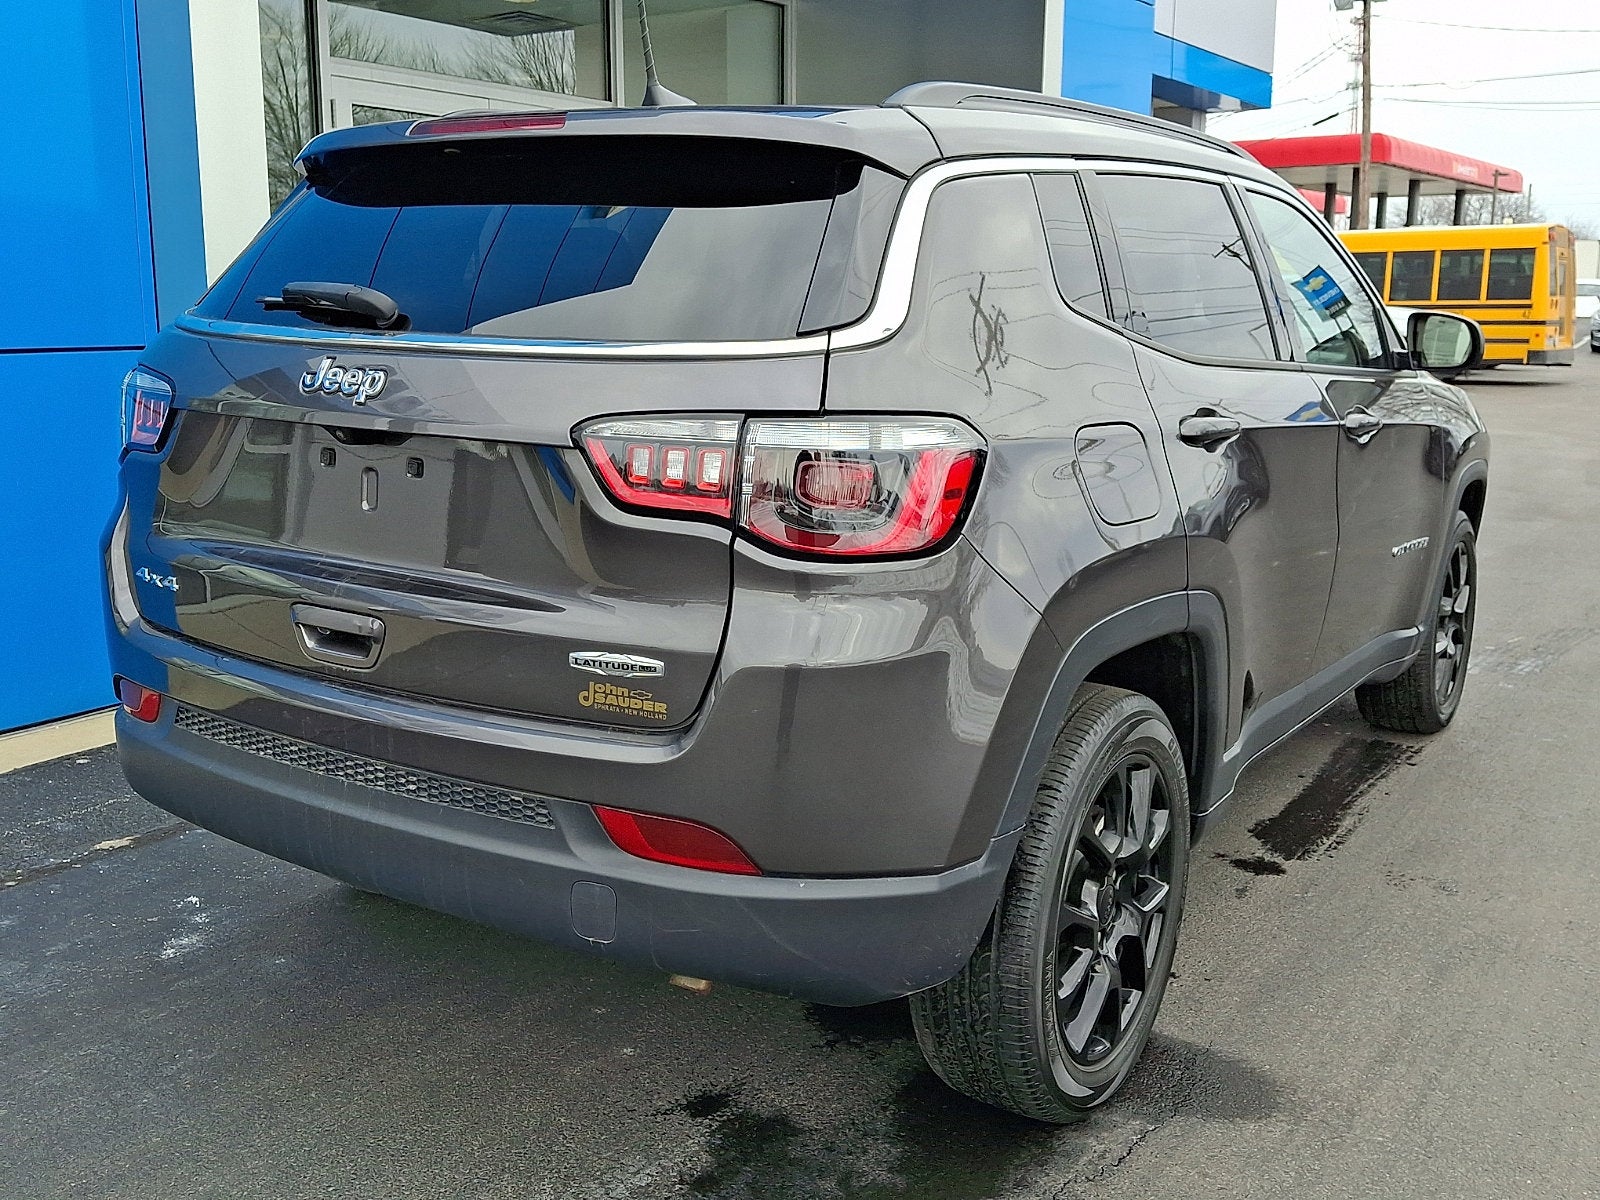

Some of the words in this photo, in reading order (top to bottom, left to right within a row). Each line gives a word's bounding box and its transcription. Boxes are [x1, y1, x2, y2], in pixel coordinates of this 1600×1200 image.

[299, 356, 388, 406] Jeep
[136, 566, 180, 592] 4x4
[573, 657, 638, 672] LATITUDE
[578, 681, 629, 707] John
[594, 693, 668, 713] SAUDER
[594, 702, 620, 713] EPHRATA
[624, 708, 637, 717] NEW
[639, 709, 667, 720] HOLLAND
